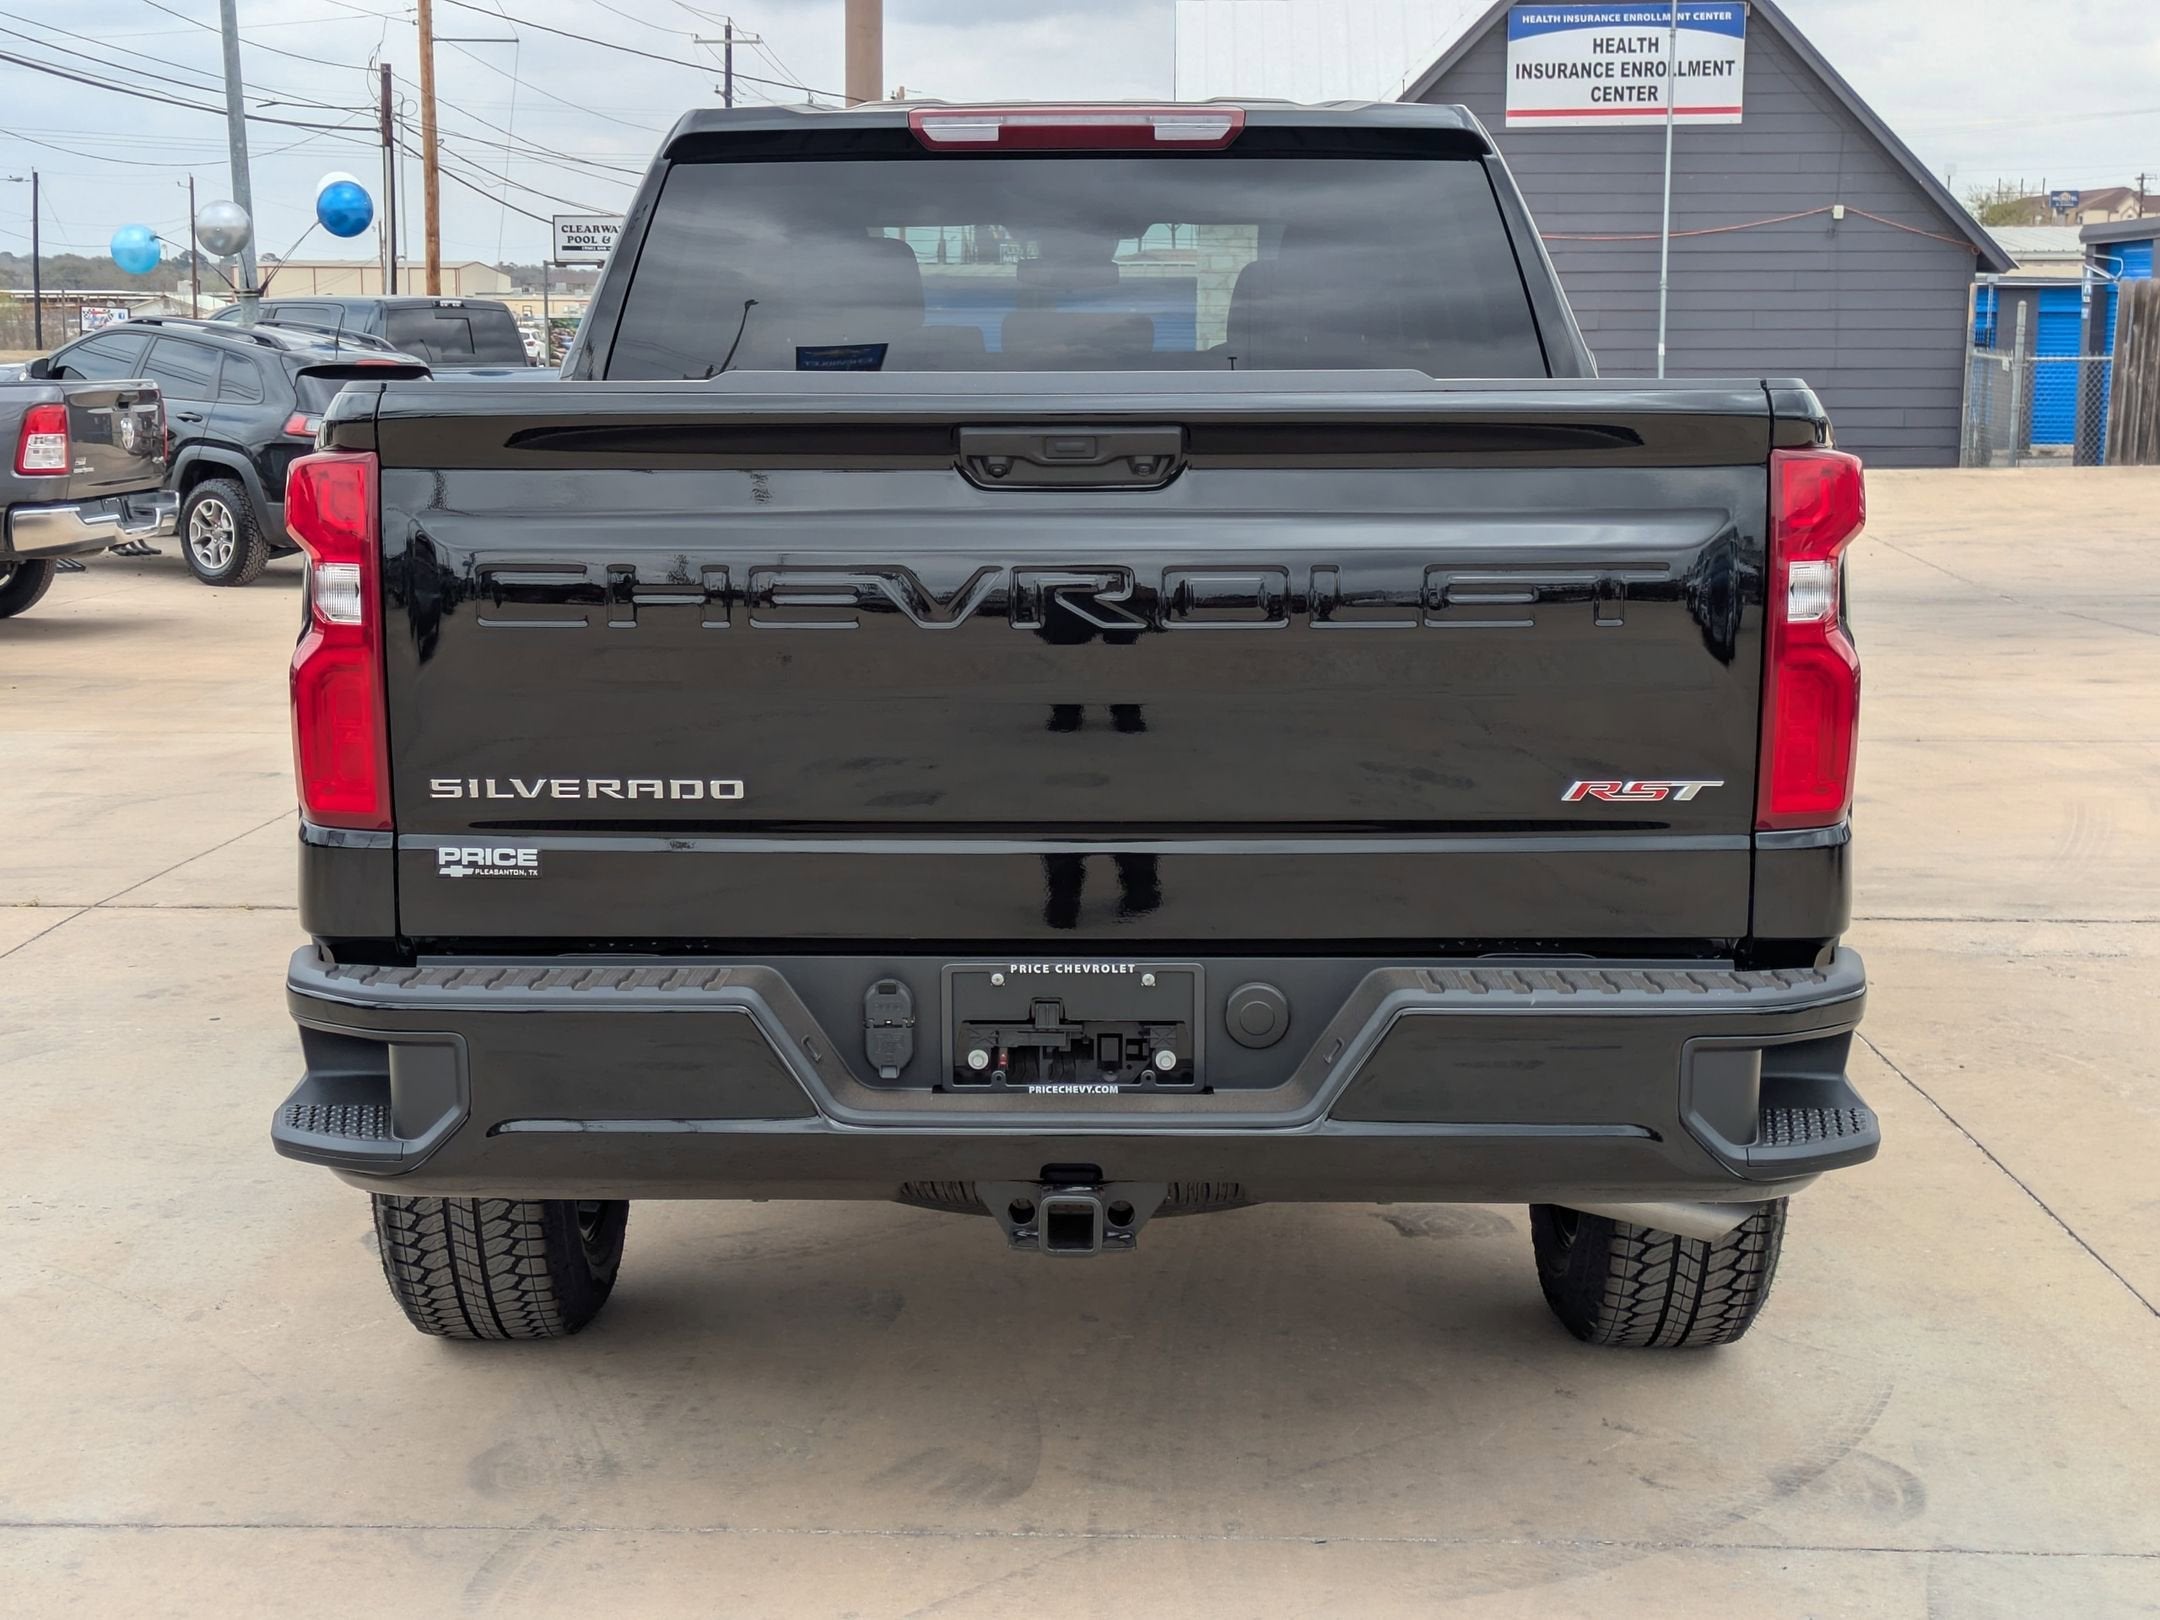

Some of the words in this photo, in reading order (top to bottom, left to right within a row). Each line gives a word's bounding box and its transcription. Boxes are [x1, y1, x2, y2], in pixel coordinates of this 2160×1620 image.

[1522, 15, 1561, 24] HEALTH
[1563, 14, 1620, 23] INSURANCE
[1623, 13, 1690, 22] ENROLLMNT
[1693, 12, 1732, 21] CENTER
[1593, 37, 1659, 54] HEALTH
[1515, 62, 1614, 79] INSURANCE
[1590, 86, 1659, 102] CENTER
[561, 225, 621, 233] CLEARWA
[567, 236, 597, 244] POOL
[602, 236, 611, 244] &
[474, 564, 1671, 630] CHEVROLET
[429, 779, 745, 799] SILVERADO
[1561, 781, 1725, 801] RST
[438, 847, 538, 866] PRICE
[475, 868, 527, 876] PLEASANTON,
[1009, 964, 1050, 974] PRICE
[1055, 964, 1136, 974] CHEVROLET
[1028, 1085, 1119, 1095] PRICECHEVY.COM
